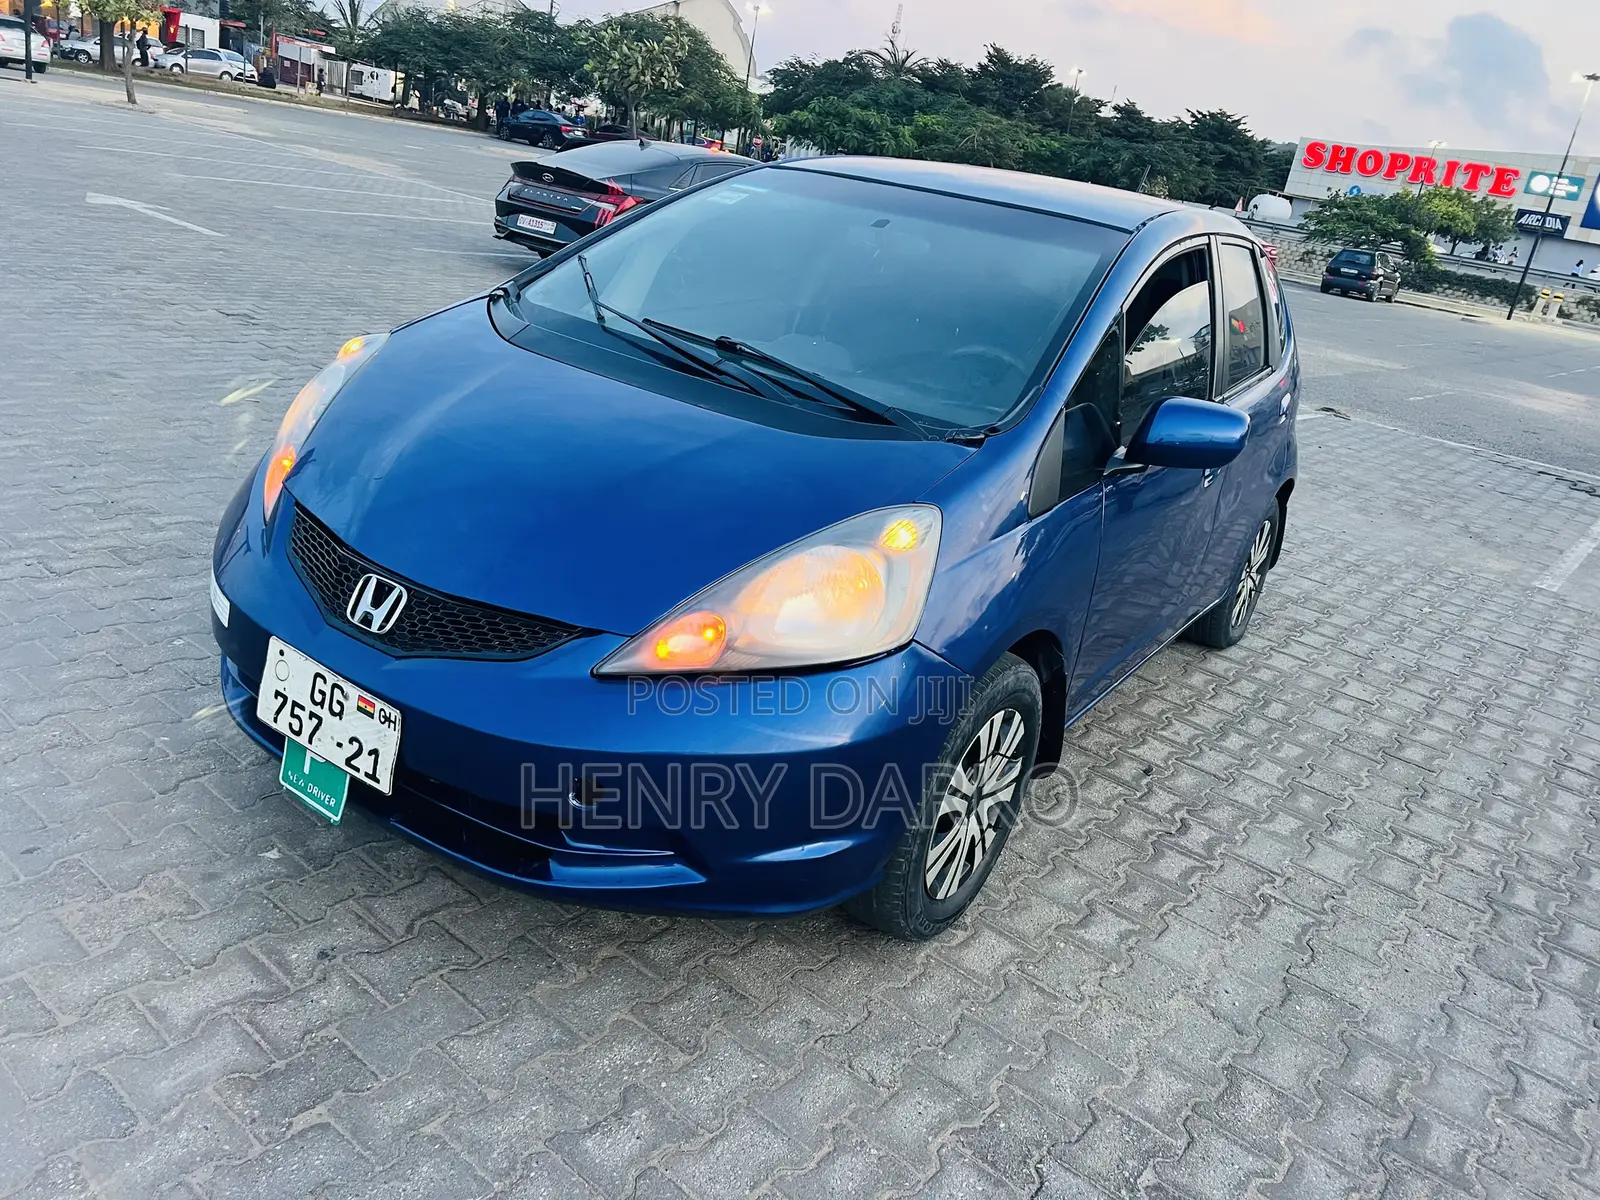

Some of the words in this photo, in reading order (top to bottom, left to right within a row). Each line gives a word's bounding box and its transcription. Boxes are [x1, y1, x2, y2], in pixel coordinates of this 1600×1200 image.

[1301, 140, 1522, 199] SHOPRITE
[310, 671, 346, 721] GG
[378, 707, 398, 731] GH
[307, 783, 336, 808] DRIVER
